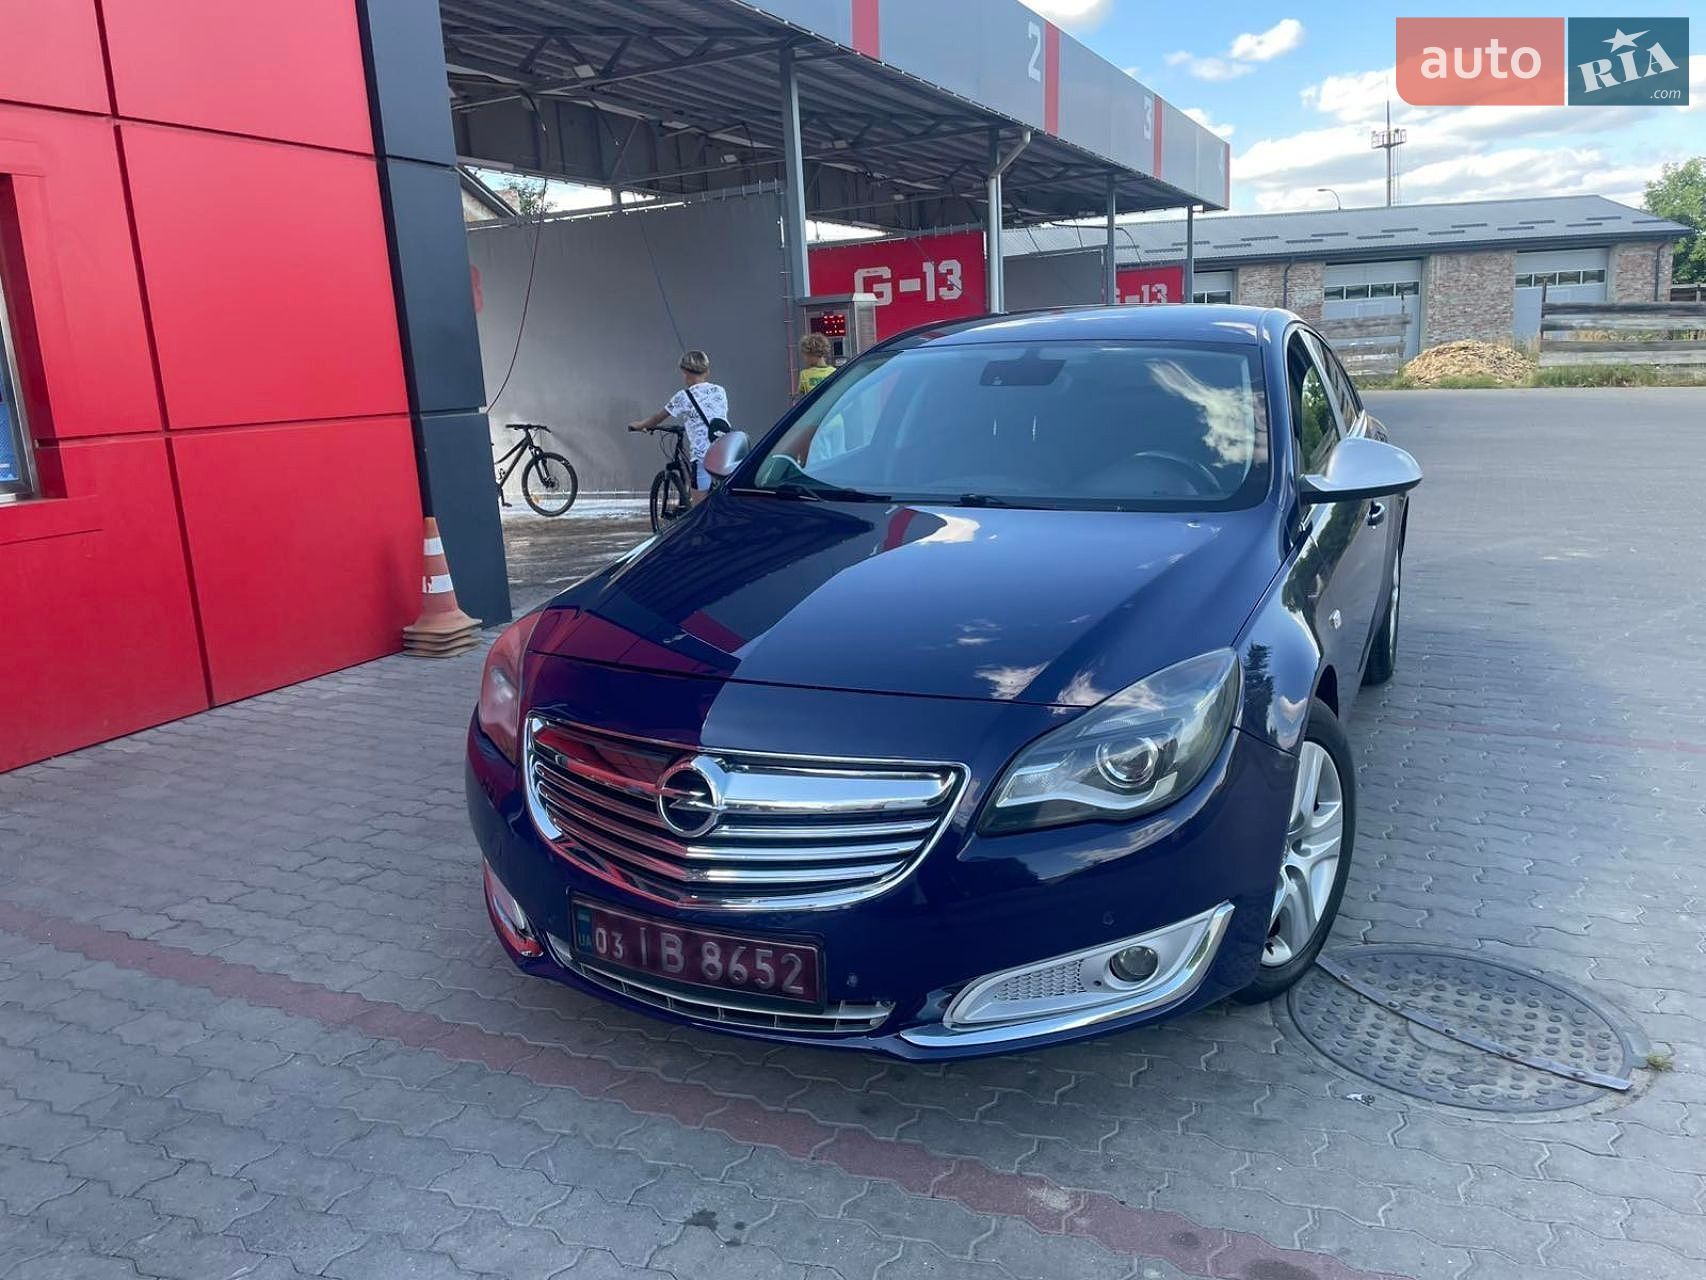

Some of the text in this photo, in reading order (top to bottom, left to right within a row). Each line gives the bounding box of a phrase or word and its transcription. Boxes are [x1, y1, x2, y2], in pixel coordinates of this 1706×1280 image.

[1027, 21, 1041, 82] 2
[1143, 95, 1153, 140] 3
[853, 259, 962, 306] G-13
[595, 927, 624, 960] 03
[700, 941, 805, 995] 8652
